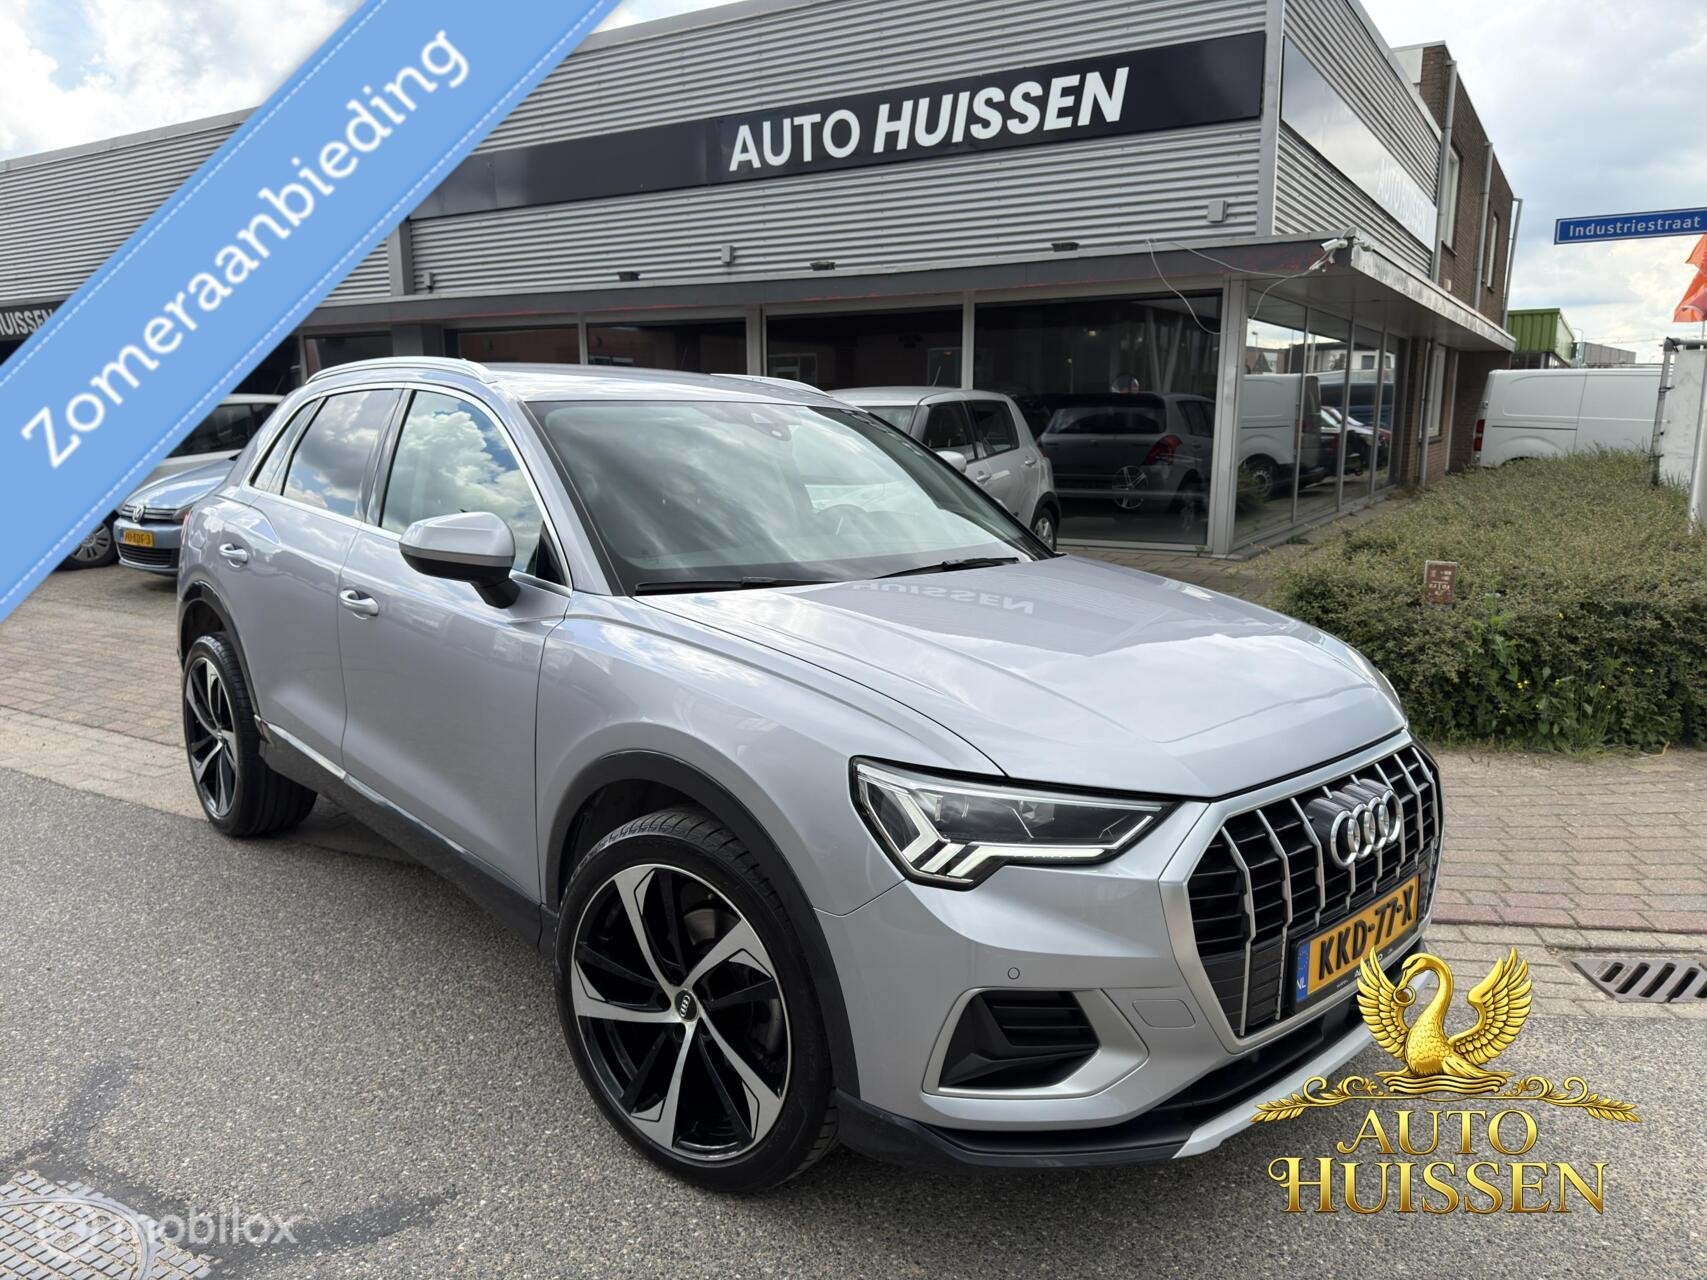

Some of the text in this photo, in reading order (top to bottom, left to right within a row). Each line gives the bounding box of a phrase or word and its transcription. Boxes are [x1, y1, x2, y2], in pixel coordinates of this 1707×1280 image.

[729, 66, 1130, 172] AUTO HUISSEN
[1569, 216, 1701, 237] Industriestraat
[1318, 884, 1415, 981] KKD-77-X
